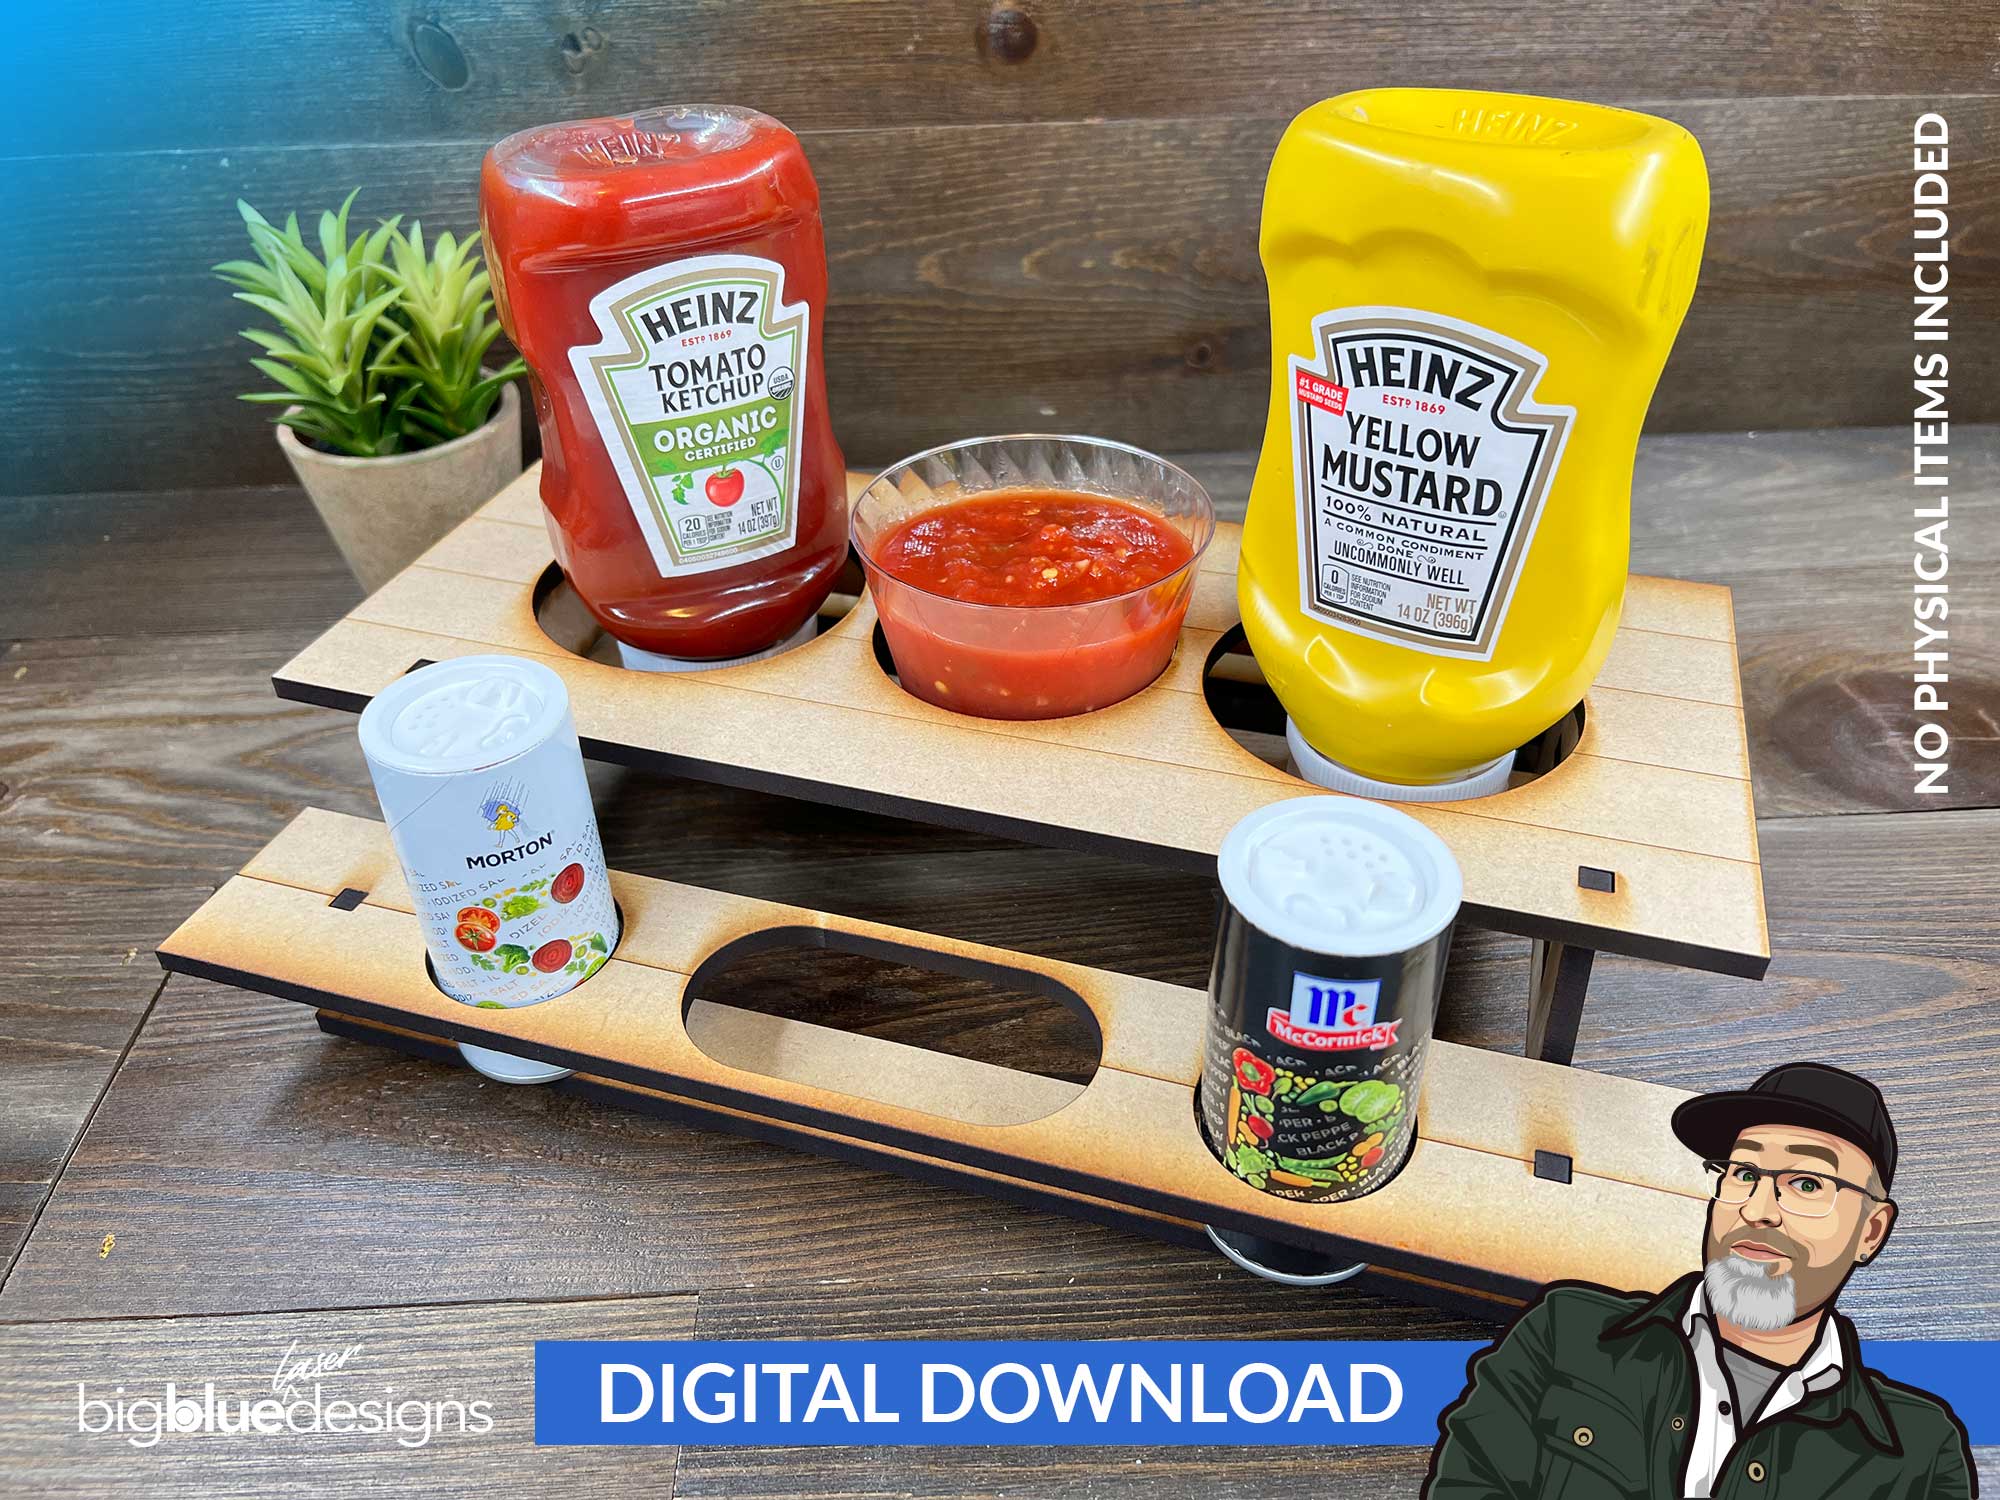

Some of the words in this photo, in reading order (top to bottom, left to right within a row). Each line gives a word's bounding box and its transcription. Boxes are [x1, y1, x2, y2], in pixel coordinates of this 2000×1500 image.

[640, 291, 759, 344] HEINZ
[708, 329, 732, 342] 1869
[649, 343, 766, 391] TOMATO
[1346, 346, 1495, 411] HEINZ
[662, 372, 764, 414] KETCHUP
[1299, 377, 1310, 390] #1
[1312, 382, 1343, 402] GRADE
[1415, 400, 1446, 415] 1869
[654, 406, 777, 453] ORGANIC
[1346, 411, 1481, 469] YELLOW
[684, 437, 756, 462] CERTIFIED
[1321, 443, 1503, 516] MUSTARD
[751, 501, 766, 517] NET
[766, 497, 778, 512] WT
[1325, 495, 1372, 522] 100%
[1382, 512, 1486, 542] NATURAL
[685, 518, 701, 532] 20
[738, 522, 747, 535] 14
[747, 518, 756, 532] OZ
[757, 511, 779, 532] (397g)
[1324, 518, 1331, 527] A
[1337, 522, 1395, 544] COMMON
[1401, 539, 1485, 561] CONDIMENT
[1377, 543, 1414, 558] DONE
[1334, 540, 1422, 577] UNCOMMONLY
[1427, 564, 1464, 585] WELL
[1323, 582, 1345, 595] CALORIES
[1331, 570, 1338, 584] 0
[1351, 574, 1361, 582] SEE
[1363, 577, 1391, 592] NUTRITION
[1350, 590, 1361, 599] FOR
[1362, 594, 1383, 606] SODIUM
[1351, 582, 1386, 599] INFORMATION
[1350, 598, 1374, 611] CONTENT
[1427, 593, 1452, 612] NET
[1455, 598, 1477, 614] WT
[1397, 603, 1410, 620] 14
[1414, 606, 1430, 624] OZ
[1433, 609, 1474, 634] (396g)
[466, 832, 553, 870] MORTON
[431, 888, 477, 906] IODIZED
[1274, 1022, 1386, 1047] McCormick
[1296, 1138, 1347, 1157] BLACK
